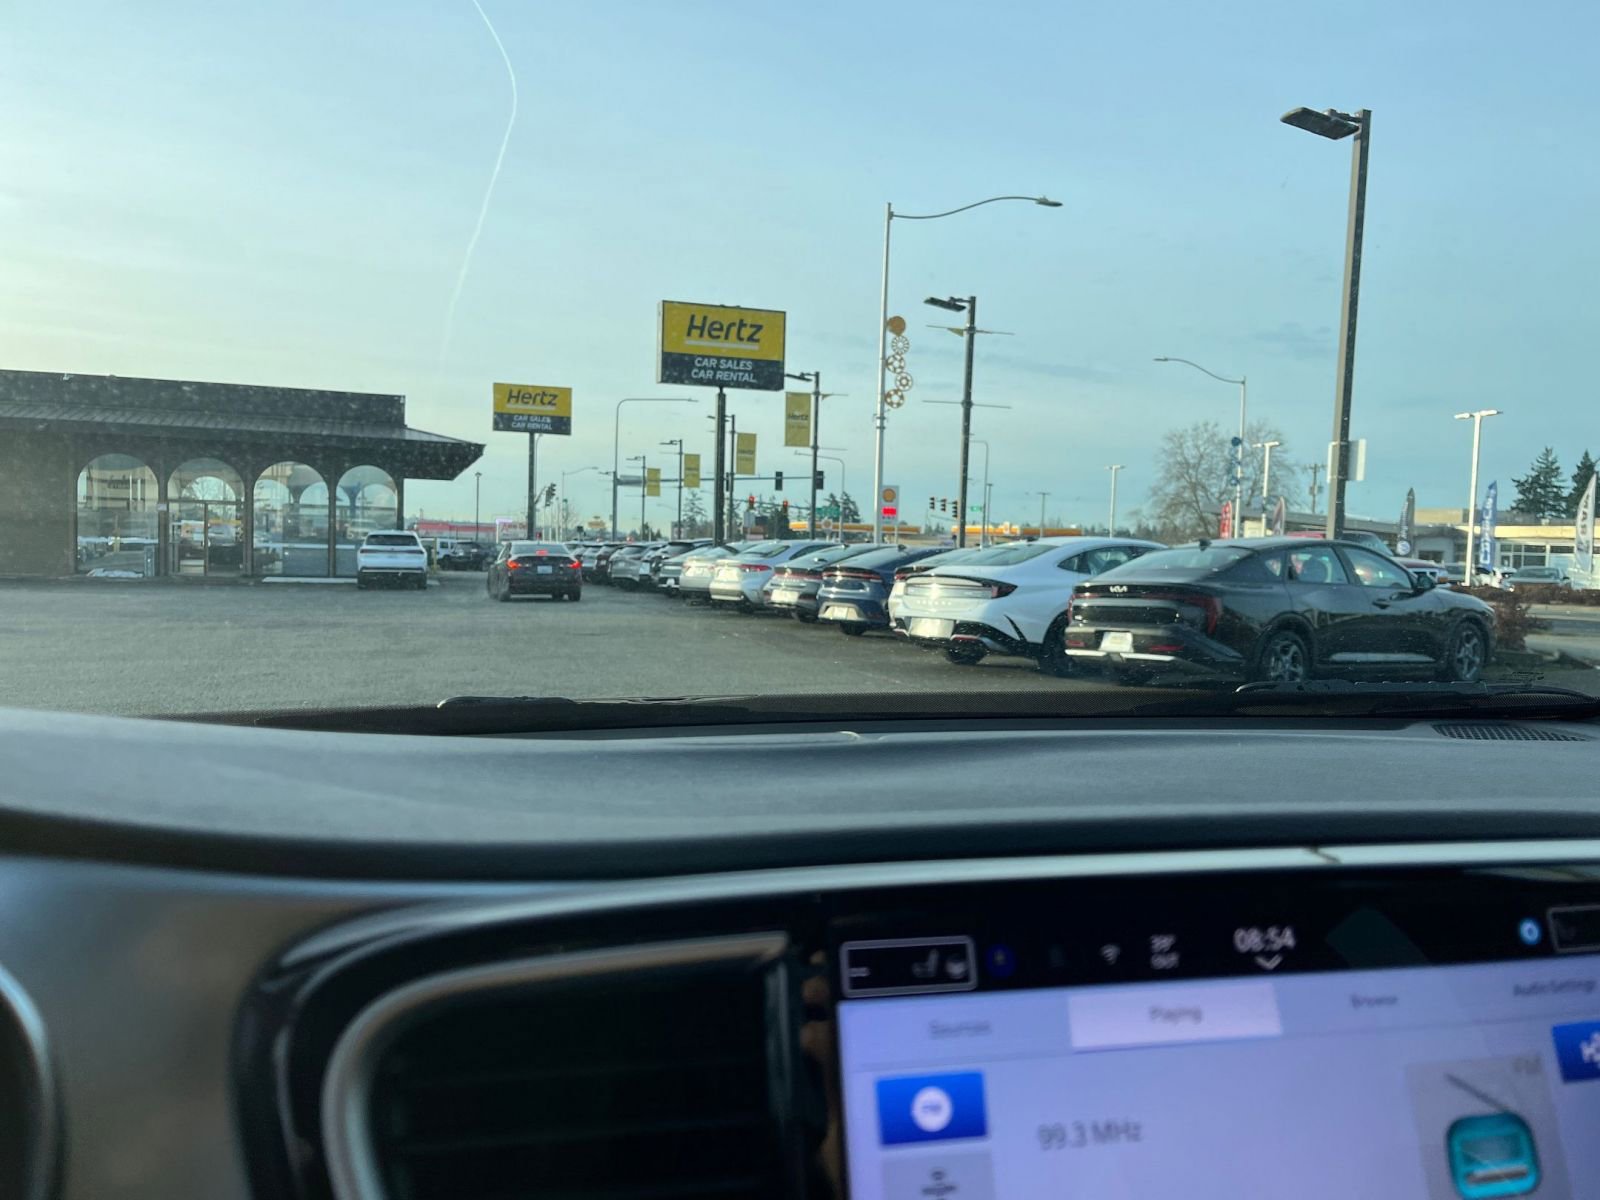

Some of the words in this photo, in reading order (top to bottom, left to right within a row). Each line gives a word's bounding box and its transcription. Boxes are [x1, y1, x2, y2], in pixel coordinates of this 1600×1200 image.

[686, 313, 764, 343] Hertz
[694, 357, 718, 368] CAR
[719, 359, 753, 371] SALES
[691, 369, 714, 380] CAR
[715, 371, 757, 383] RENTAL
[507, 388, 559, 406] Hertz
[513, 414, 528, 422] CAR
[529, 415, 551, 423] SALES
[526, 423, 553, 431] RENTAL
[1233, 926, 1296, 953] 08:54
[1038, 1120, 1086, 1150] 99.3
[1091, 1117, 1142, 1145] MHz
